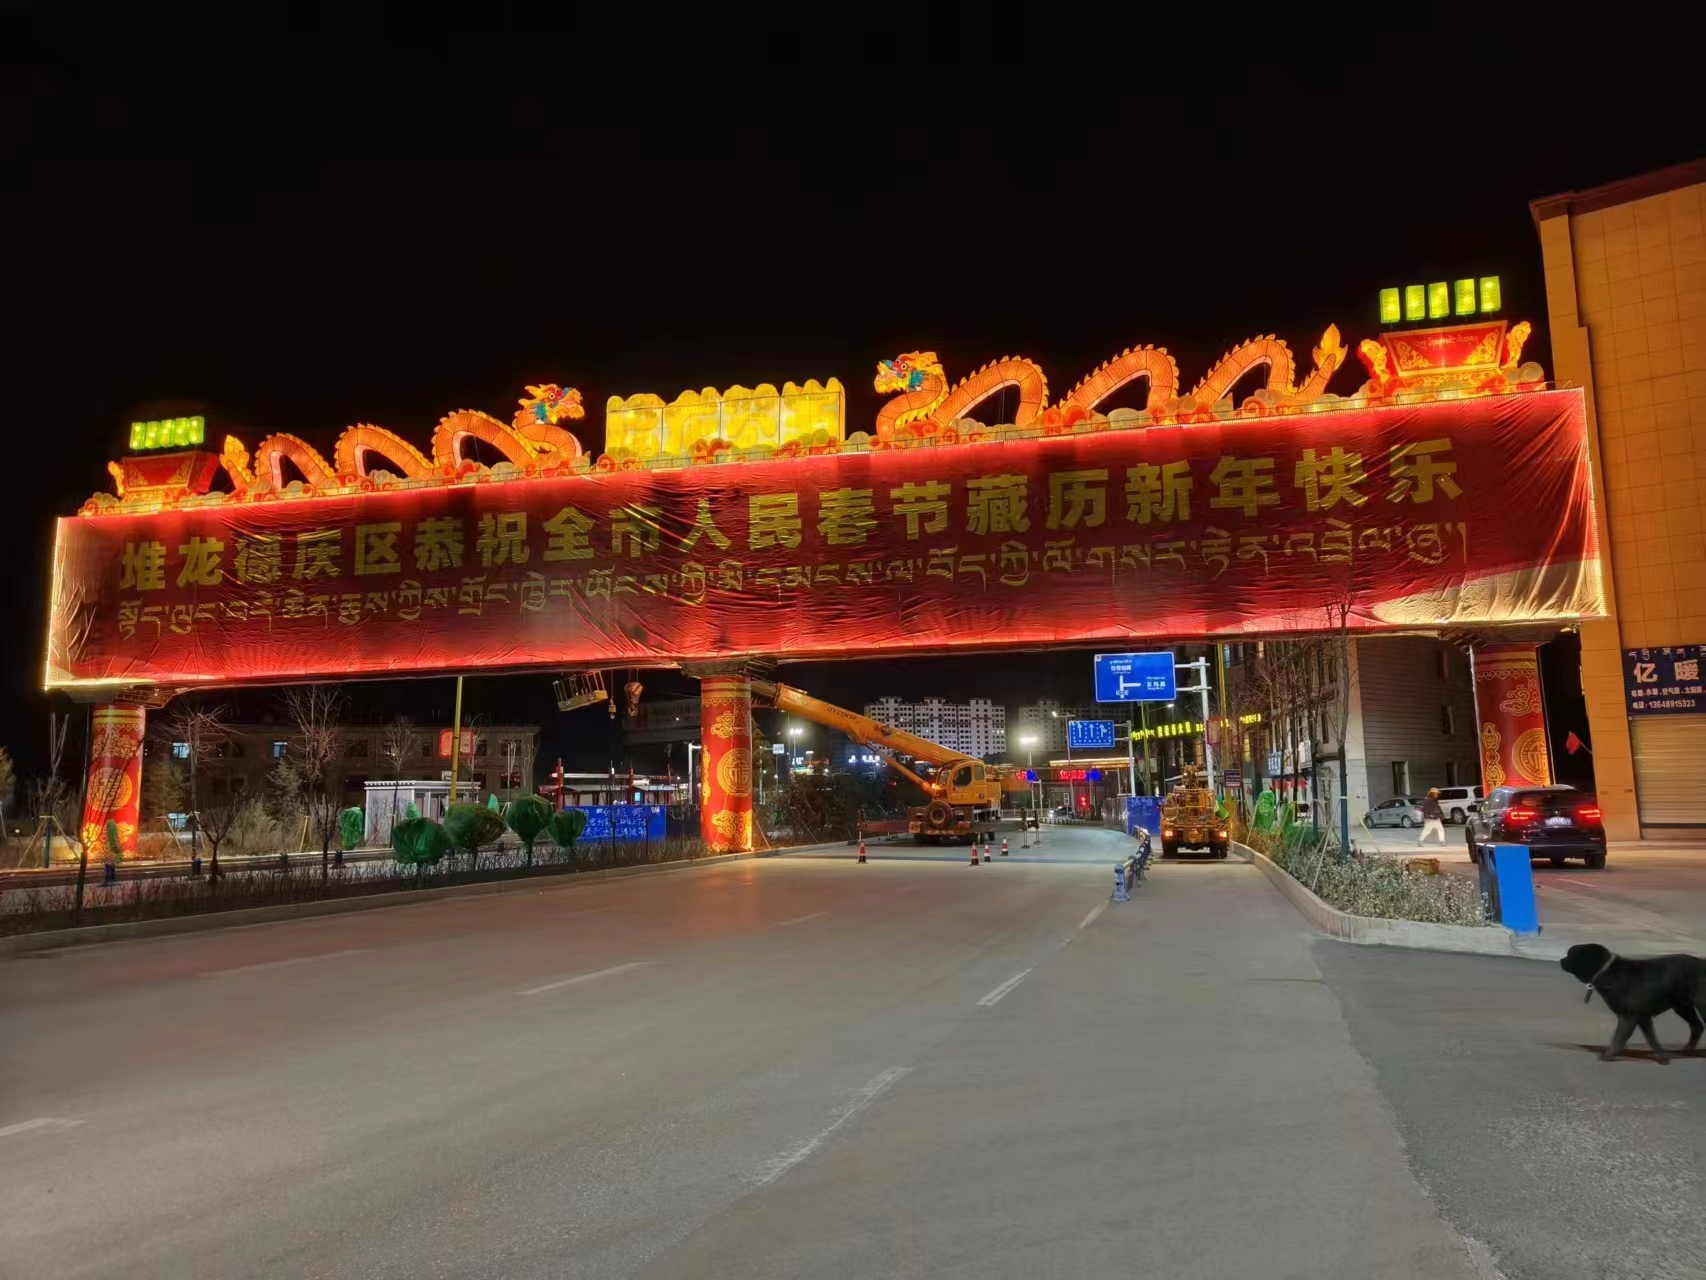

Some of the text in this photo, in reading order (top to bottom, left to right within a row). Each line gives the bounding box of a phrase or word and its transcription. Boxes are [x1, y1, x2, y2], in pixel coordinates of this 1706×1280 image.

[119, 437, 1464, 591] 堆龙德庆区恭祝全市人民春节藏历新年快乐
